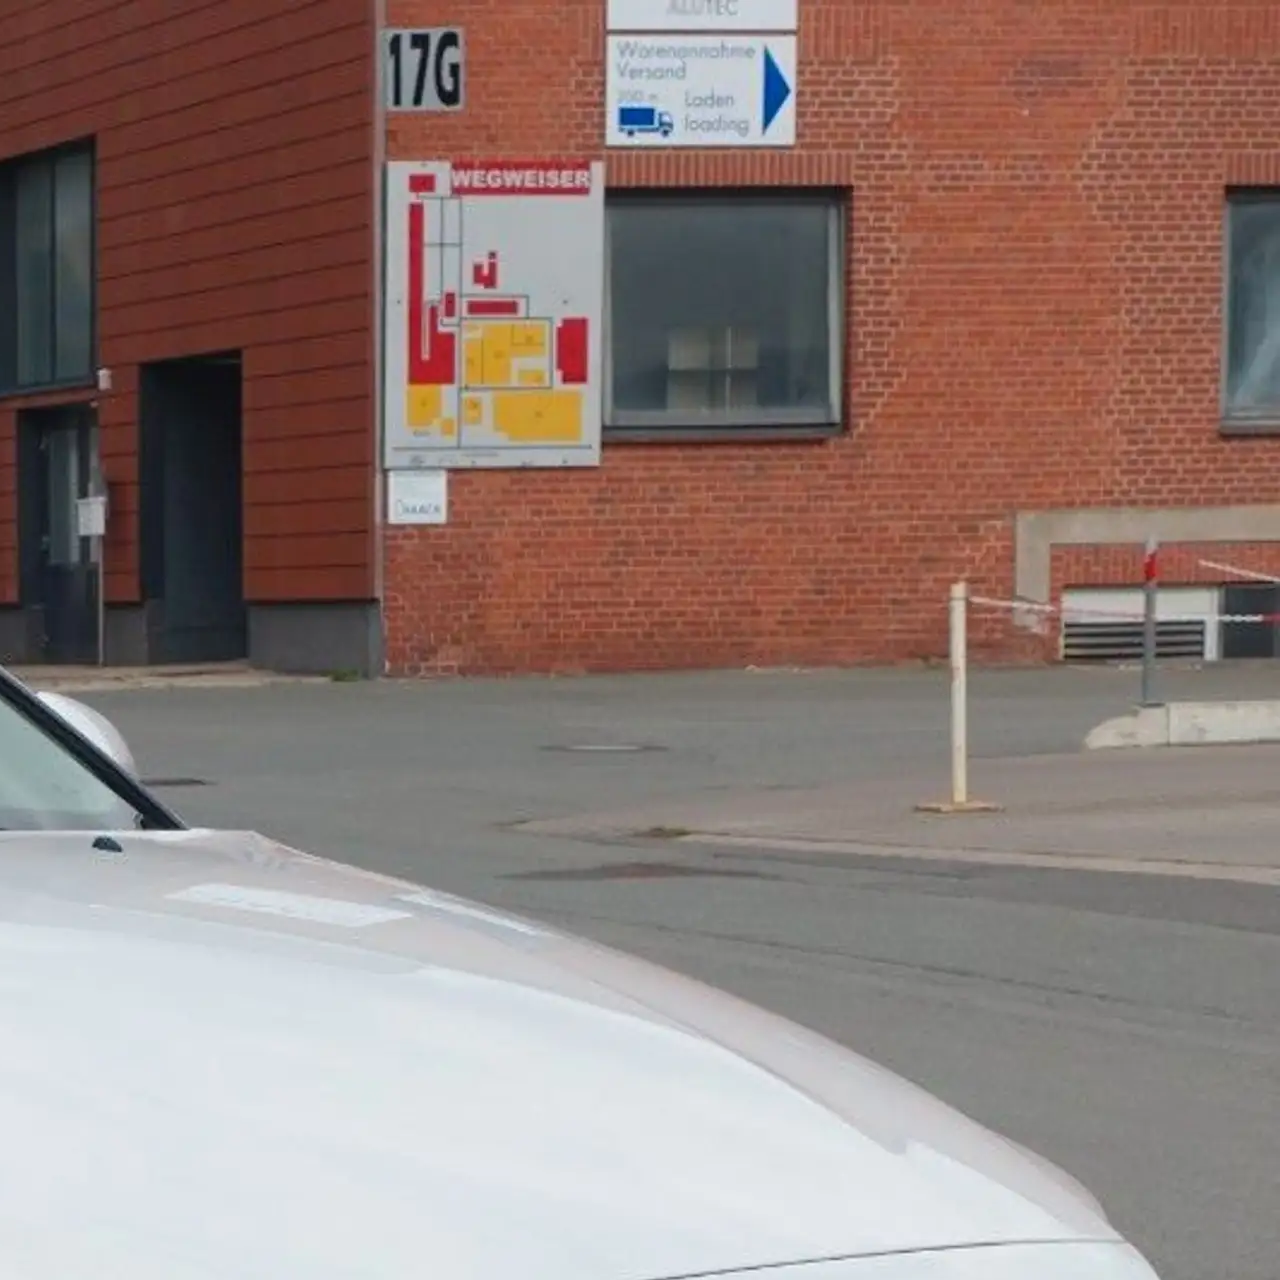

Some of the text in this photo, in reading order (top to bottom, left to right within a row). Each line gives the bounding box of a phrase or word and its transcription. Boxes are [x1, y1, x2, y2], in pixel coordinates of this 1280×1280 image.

[617, 41, 756, 60] Warenannahme
[390, 31, 461, 107] 17G
[617, 61, 687, 80] Versand
[685, 87, 734, 108] Laden
[685, 114, 750, 137] loading
[452, 169, 590, 188] WEGWEISER
